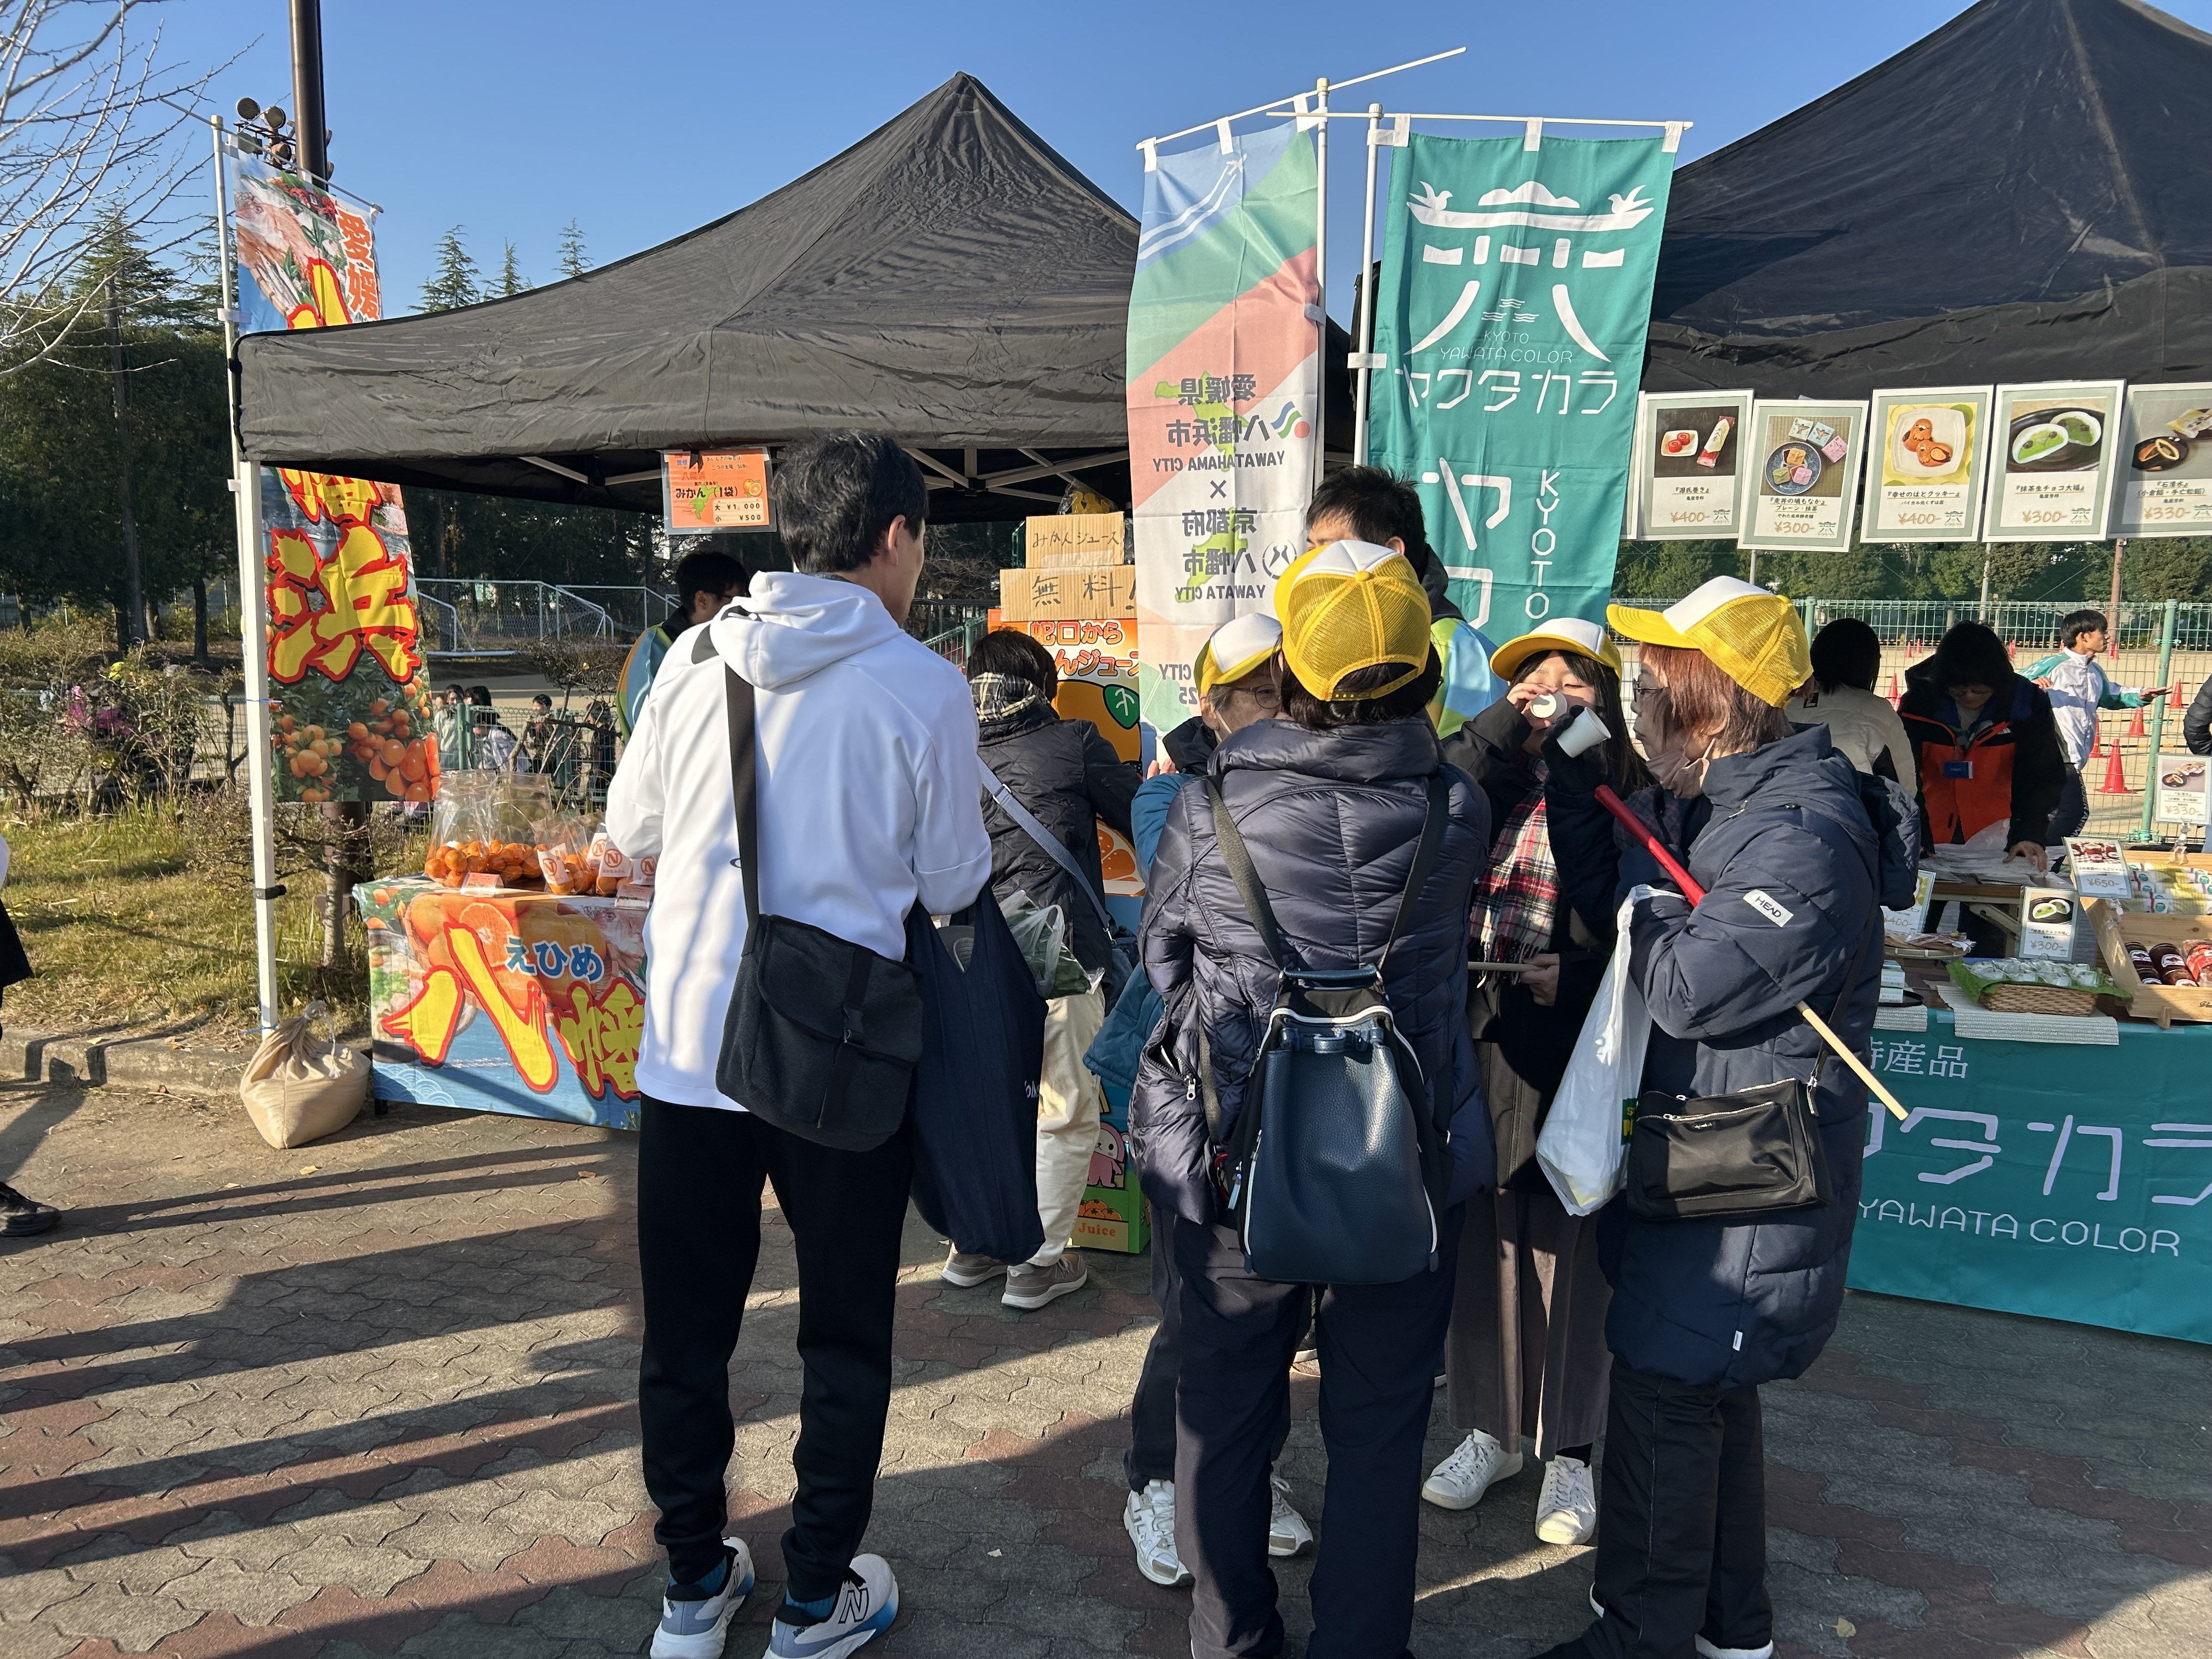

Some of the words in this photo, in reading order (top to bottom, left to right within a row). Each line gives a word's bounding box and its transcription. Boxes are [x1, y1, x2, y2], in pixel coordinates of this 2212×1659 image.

[335, 205, 380, 321] 愛媛
[1484, 330, 1529, 344] KYOTO
[1440, 346, 1506, 360] YAWATA
[1511, 349, 1573, 363] COLOR
[1394, 364, 1617, 415] ヤワタカラ
[1032, 531, 1120, 548] みかんジュース
[1525, 469, 1560, 619] KYOTO
[1029, 620, 1124, 646] 蛇口から
[1754, 896, 1781, 917] HEAD
[504, 935, 605, 982] えひめ
[1079, 1222, 1116, 1237] Juice
[1858, 1198, 2019, 1239] YAWATA
[2030, 1218, 2180, 1257] COLOR
